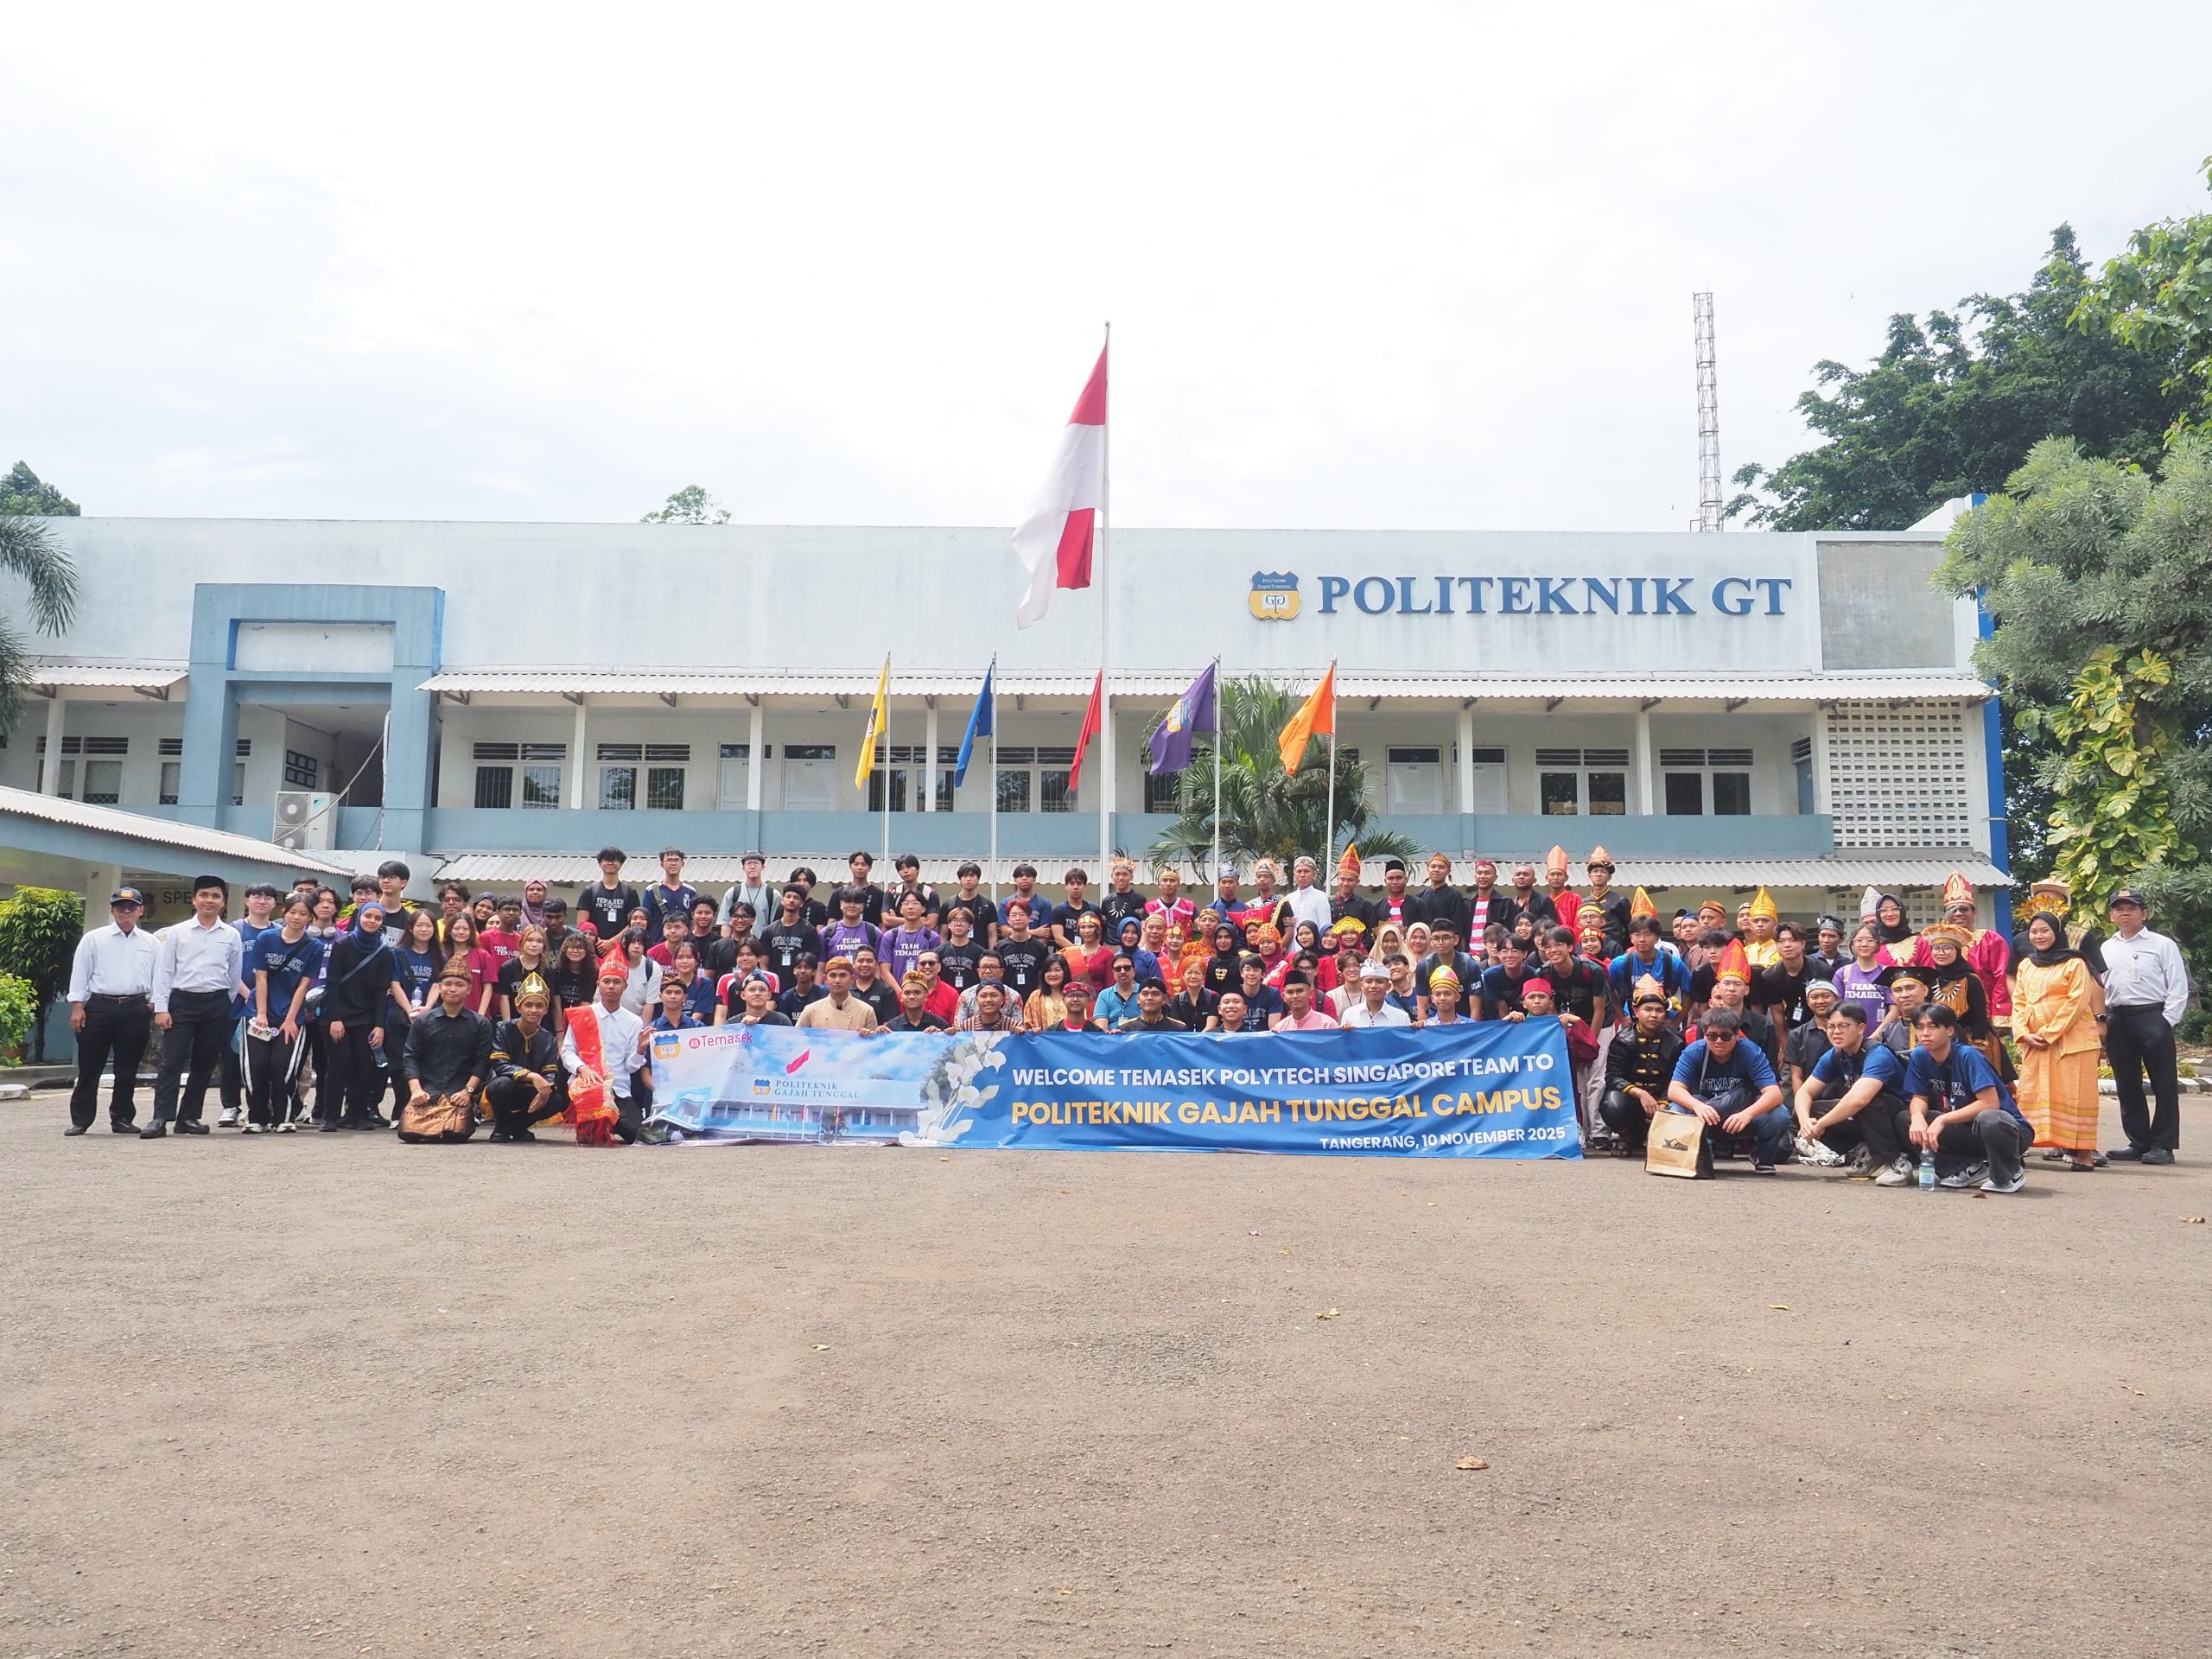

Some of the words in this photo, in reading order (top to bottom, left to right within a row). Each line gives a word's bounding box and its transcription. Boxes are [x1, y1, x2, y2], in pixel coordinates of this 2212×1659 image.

[1317, 576, 1697, 615] POLITEKNIK
[1711, 577, 1792, 615] GT
[701, 1031, 753, 1047] Temasek
[1012, 1068, 1115, 1086] WELCOME
[1119, 1069, 1217, 1086] TEMASEK
[1220, 1067, 1329, 1085] POLYTECH
[1333, 1061, 1455, 1083] SINGAPORE
[1459, 1056, 1519, 1076] TEAM
[1522, 1053, 1554, 1072] TO
[774, 1088, 808, 1096] GAJAH
[812, 1090, 860, 1098] TUNGGAL
[777, 1080, 837, 1090] POLITEKNIK
[1011, 1101, 1172, 1124] POLITEKNIK
[1178, 1101, 1281, 1123] GAJAH
[1286, 1095, 1427, 1122] TUNGGAL
[1432, 1086, 1561, 1116] CAMPUS
[1319, 1135, 1419, 1150] TANGERANG,
[1421, 1134, 1438, 1147] 10
[1440, 1128, 1525, 1146] NOVEMBER
[1528, 1127, 1566, 1141] 2025
